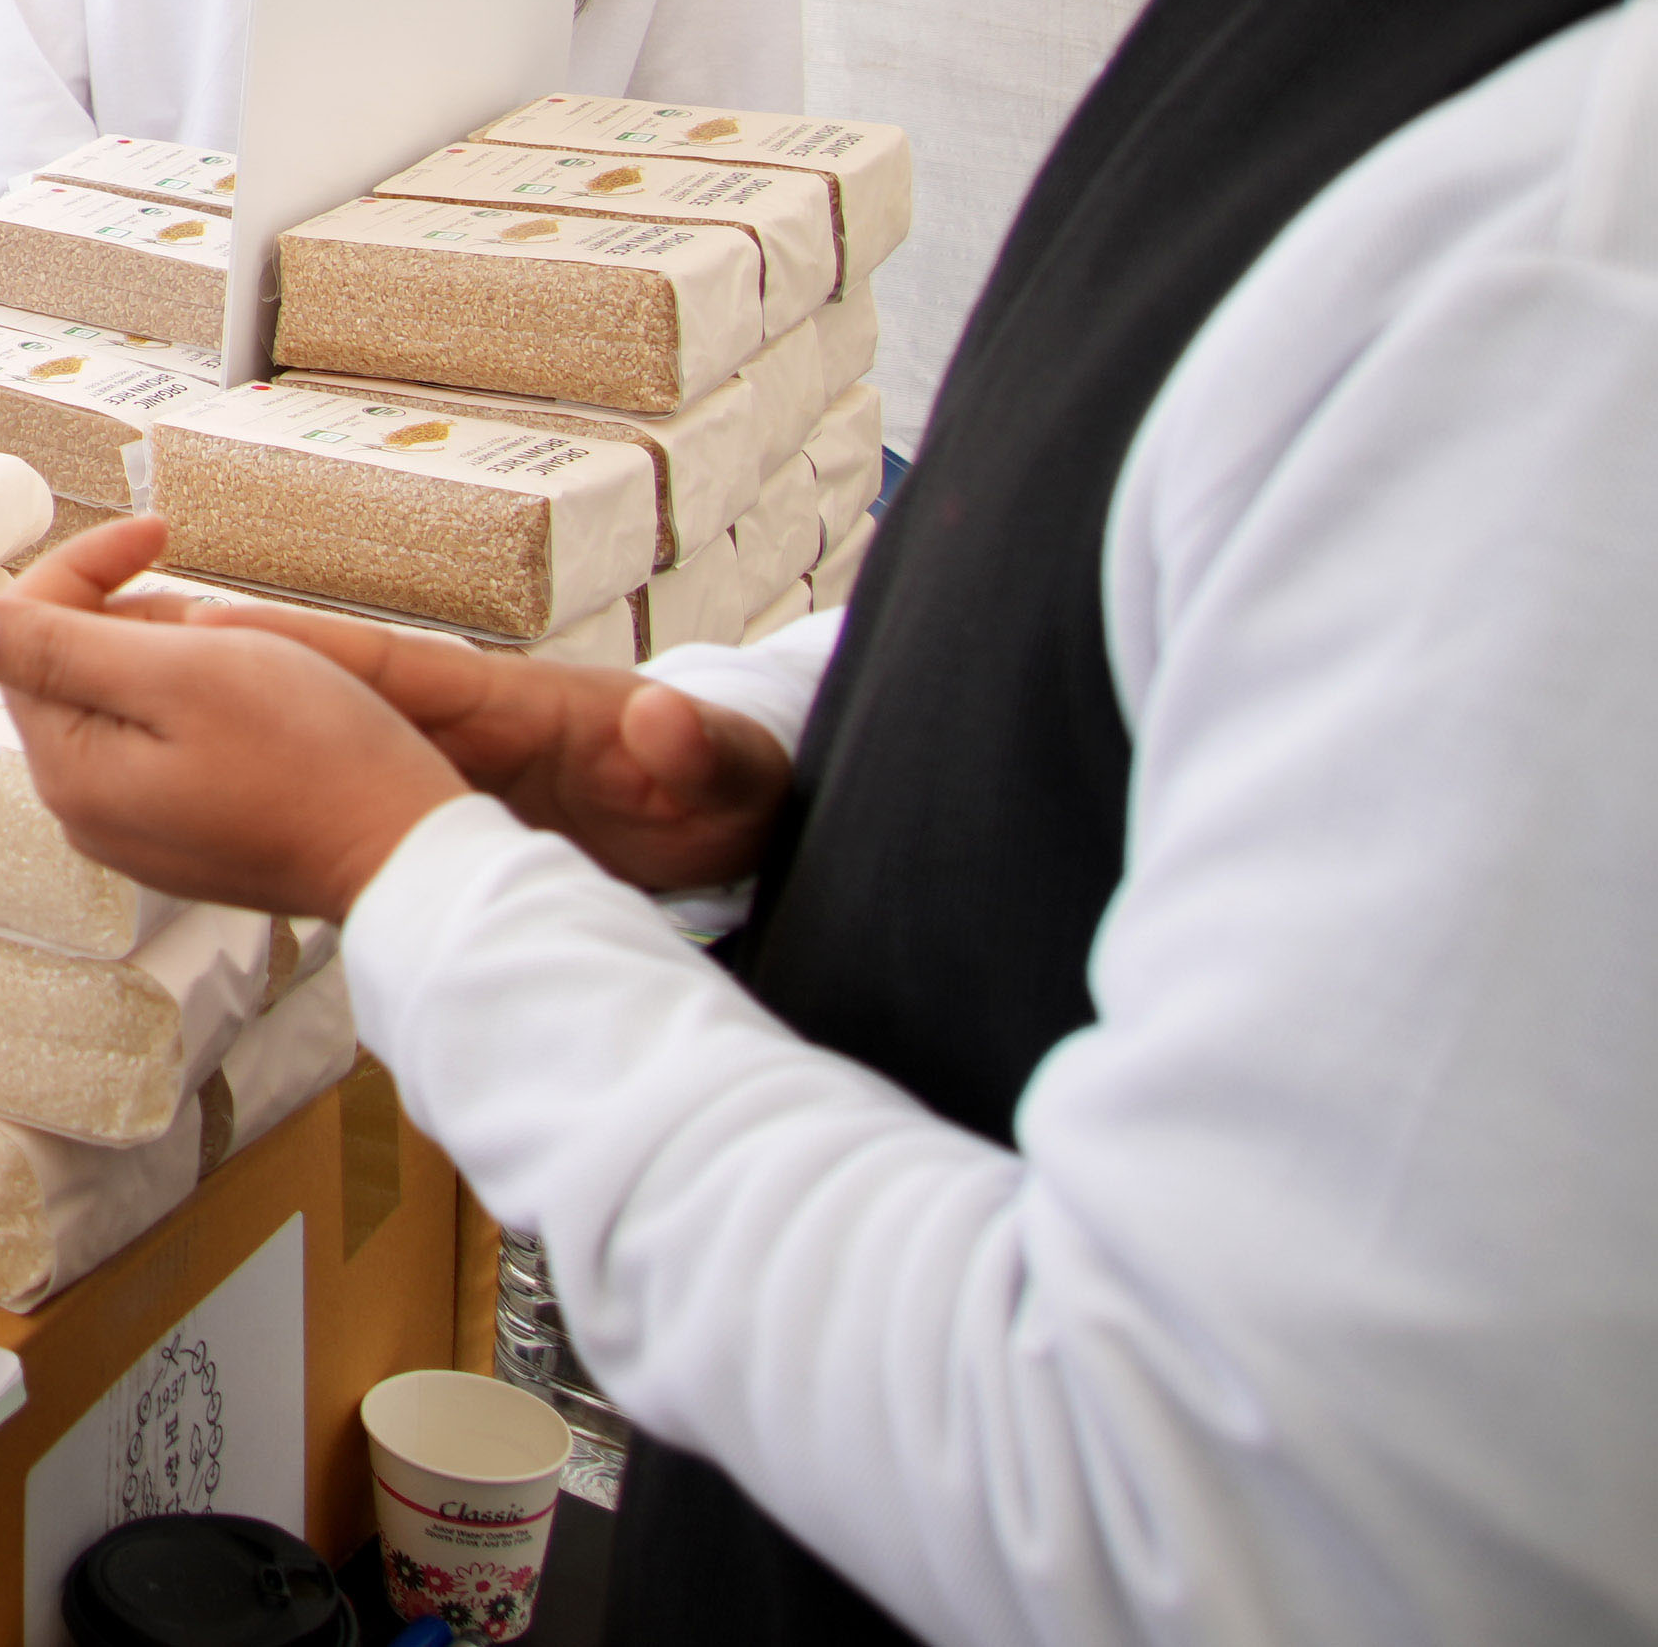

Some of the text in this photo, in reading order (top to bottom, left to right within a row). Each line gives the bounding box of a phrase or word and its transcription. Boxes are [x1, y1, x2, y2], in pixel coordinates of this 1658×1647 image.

[819, 133, 864, 158] ORGANIC
[706, 172, 752, 193] BROWN
[723, 179, 773, 205] ORGANIC
[688, 193, 722, 206] RICE
[604, 225, 673, 255] BROWN RICE
[641, 232, 694, 254] ORGANIC
[103, 374, 177, 406] BROWN RICE
[134, 383, 188, 410] ORGANIC
[486, 438, 571, 474] BROWN RICE
[525, 448, 589, 476] ORGANIC
[156, 1370, 186, 1419] 1937
[438, 1501, 525, 1523] Classic
